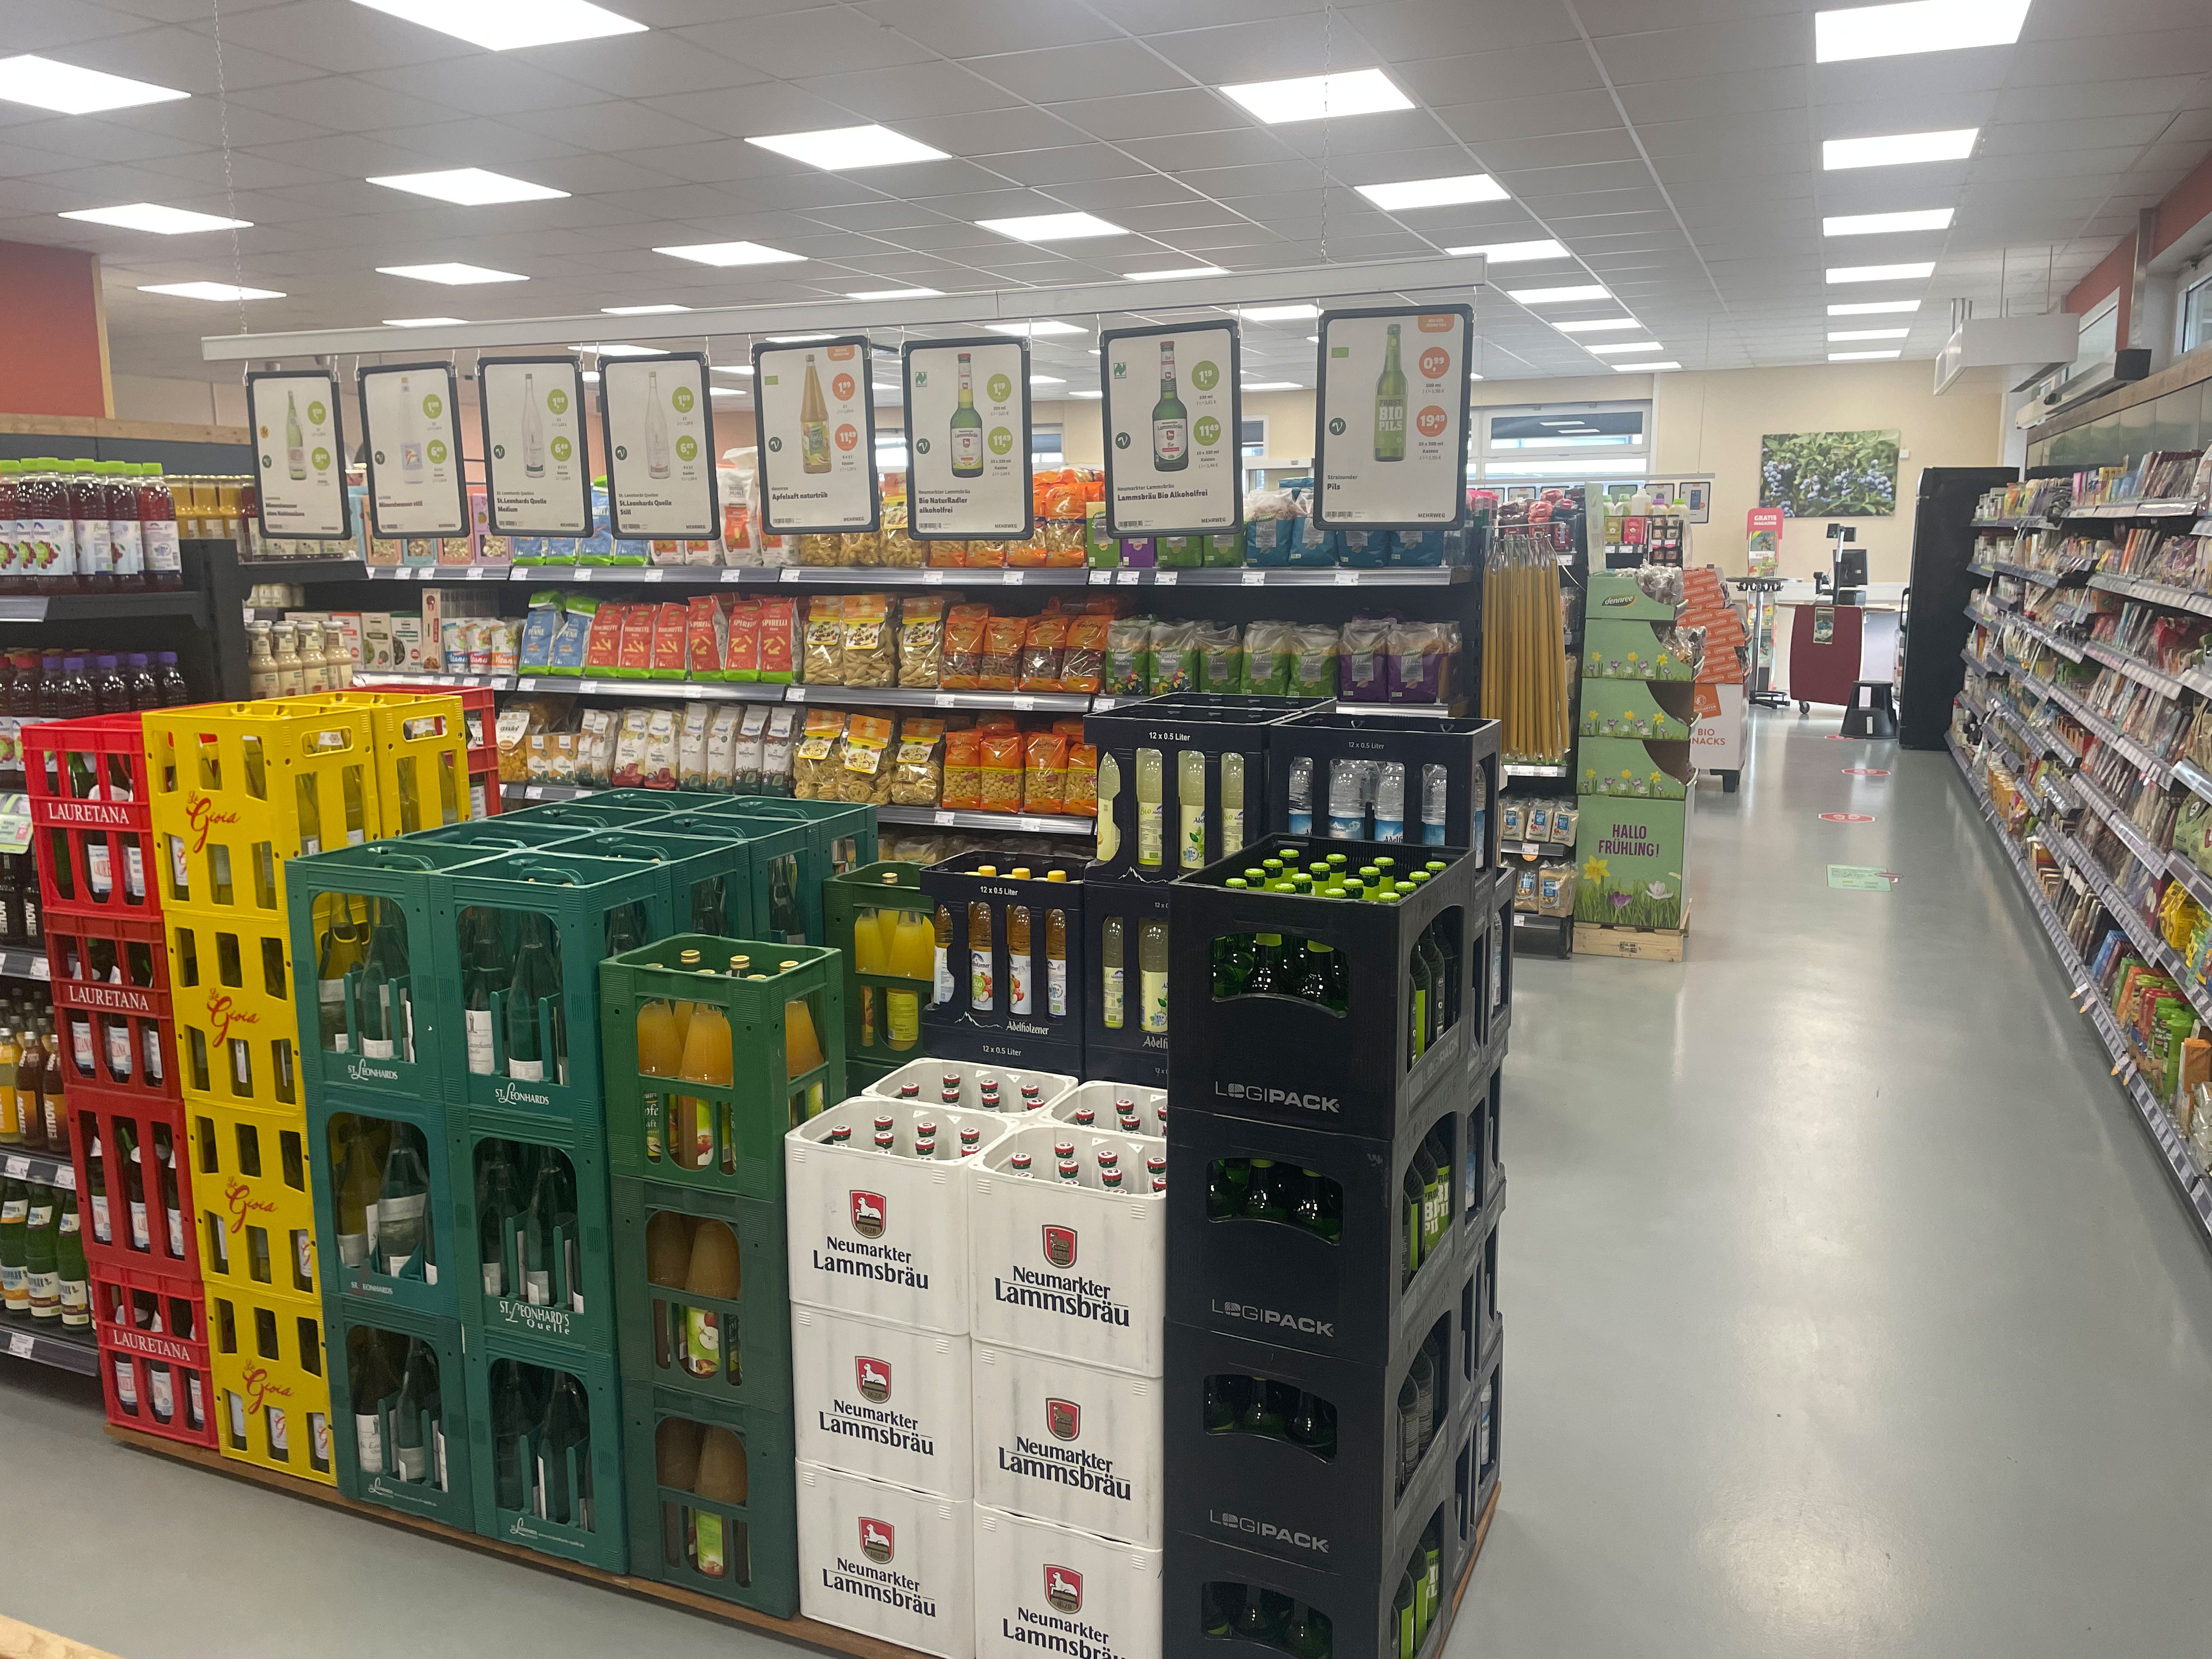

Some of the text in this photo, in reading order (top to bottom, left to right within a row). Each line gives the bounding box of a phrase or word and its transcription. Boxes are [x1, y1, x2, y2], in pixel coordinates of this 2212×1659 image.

[1423, 357, 1444, 372] 0,99
[1199, 370, 1212, 384] 1,19
[838, 382, 851, 395] 1,99
[993, 382, 1005, 396] 1,19
[1379, 407, 1403, 420] BIO
[1420, 415, 1446, 429] 19,49
[1199, 424, 1219, 438] 11,49
[1379, 421, 1402, 431] PILS
[840, 431, 856, 444] 11,49
[993, 435, 1012, 448] 11,49
[680, 443, 694, 455] 6,49
[772, 493, 799, 501] Apfelsaft
[1118, 492, 1156, 501] Lammsbräu
[1170, 489, 1208, 498] Alkoholfrei
[1605, 595, 1634, 606] dennree
[1175, 733, 1190, 741] Liter
[1691, 737, 1726, 746] NACKS
[48, 802, 129, 824] LAURETANA
[1141, 807, 1151, 815] Bio
[187, 797, 240, 854] Gioia
[1612, 824, 1647, 840] HALLO
[1599, 838, 1660, 857] FRÜHLING!
[1004, 888, 1018, 896] Liter
[69, 985, 149, 1011] LAURETANA
[207, 995, 262, 1048] Gioia
[1006, 1020, 1049, 1035] Adelholzener
[1007, 1048, 1023, 1057] Liter
[348, 1059, 398, 1081] ST. LEONHARDS
[495, 1082, 550, 1105] ST. LEONHARDS
[1215, 1081, 1340, 1114] LOGIPACK
[225, 1185, 279, 1234] Gioia
[861, 1226, 877, 1235] 1628
[826, 1235, 911, 1263] Neumarkter
[813, 1249, 929, 1290] Lammsbräu
[1012, 1265, 1110, 1300] Neumarkter
[994, 1278, 1130, 1327] Lammsbräu
[500, 1300, 570, 1327] ST. LEONHARD'S
[1211, 1298, 1335, 1338] LOGIPACK
[526, 1319, 571, 1335] Quelle
[113, 1330, 190, 1362] LAURETANA
[833, 1399, 918, 1430] Neumarkter
[819, 1411, 934, 1456] Lammsbräu
[1016, 1436, 1113, 1473] Neumarkter
[998, 1447, 1131, 1501] Lammsbräu
[1210, 1509, 1329, 1554] LOGIPACK
[837, 1557, 920, 1592] Neumarkter
[822, 1568, 936, 1617] Lammsbräu
[1018, 1606, 1109, 1645] Neumarkter
